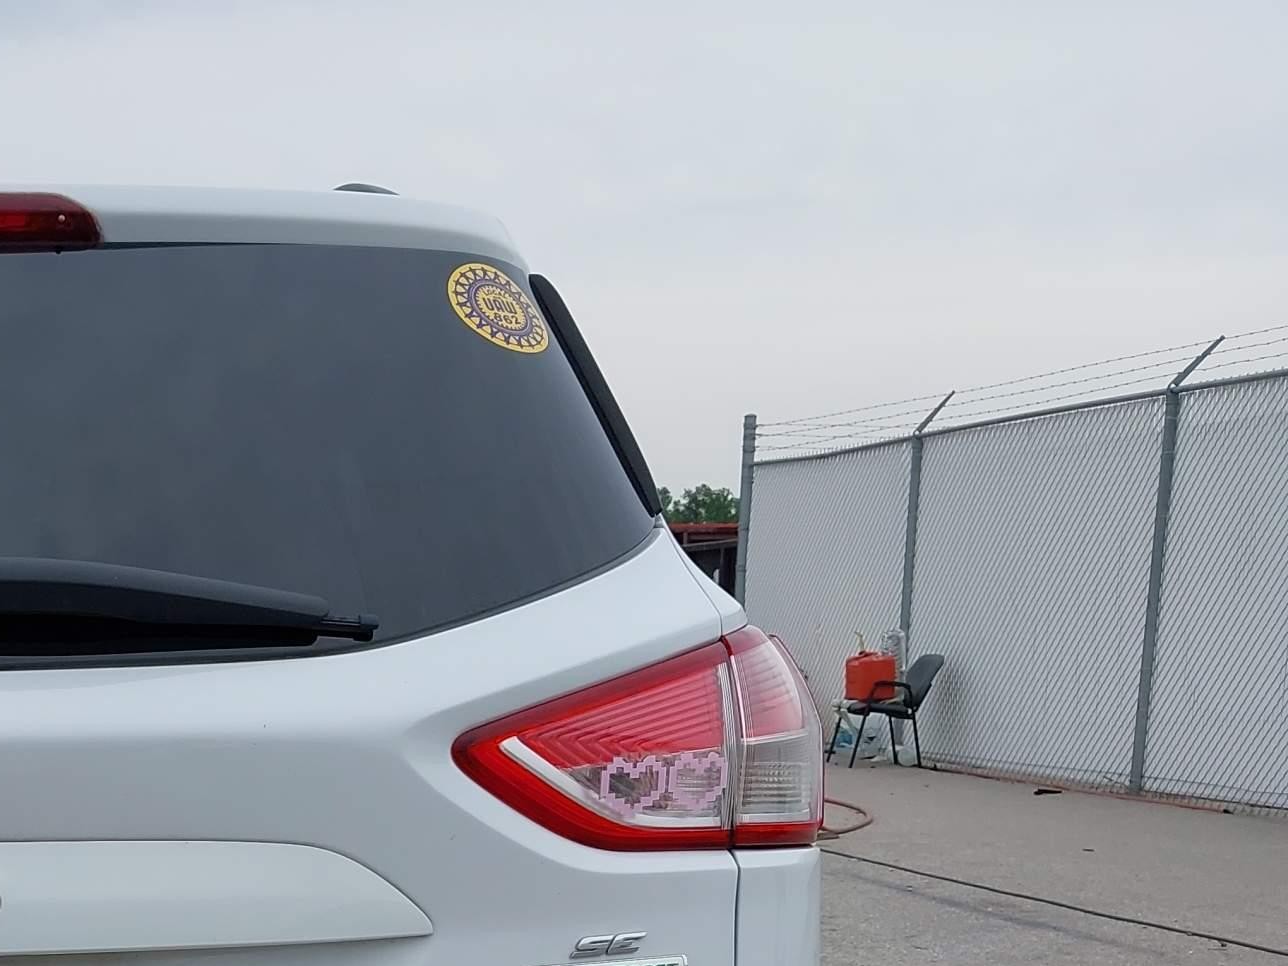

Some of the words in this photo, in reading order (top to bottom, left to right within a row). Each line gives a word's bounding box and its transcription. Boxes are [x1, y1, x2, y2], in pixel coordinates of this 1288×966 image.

[483, 297, 517, 315] UAW
[494, 312, 522, 325] 862
[569, 931, 648, 959] SE
